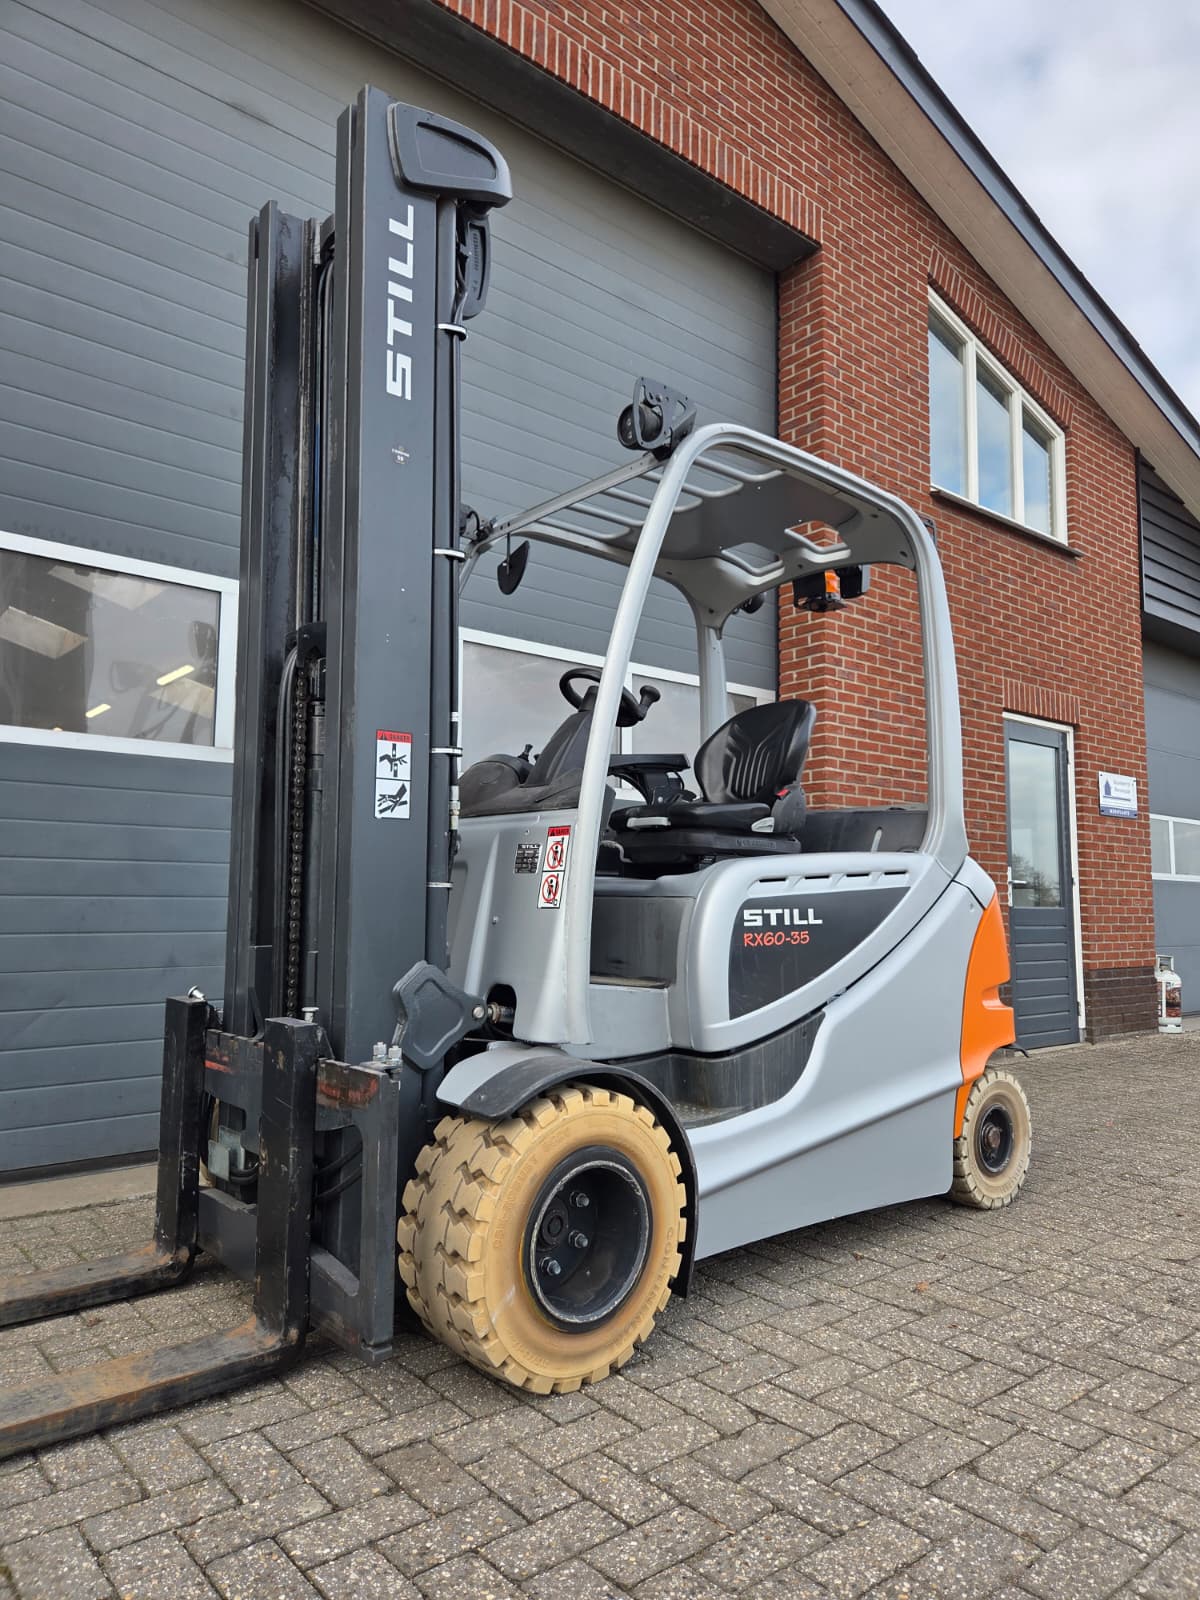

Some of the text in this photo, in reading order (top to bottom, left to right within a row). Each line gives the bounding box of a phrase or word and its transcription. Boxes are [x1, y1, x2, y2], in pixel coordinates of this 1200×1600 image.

[386, 204, 414, 401] STILL
[743, 908, 823, 926] STILL
[743, 930, 810, 947] RX60-35
